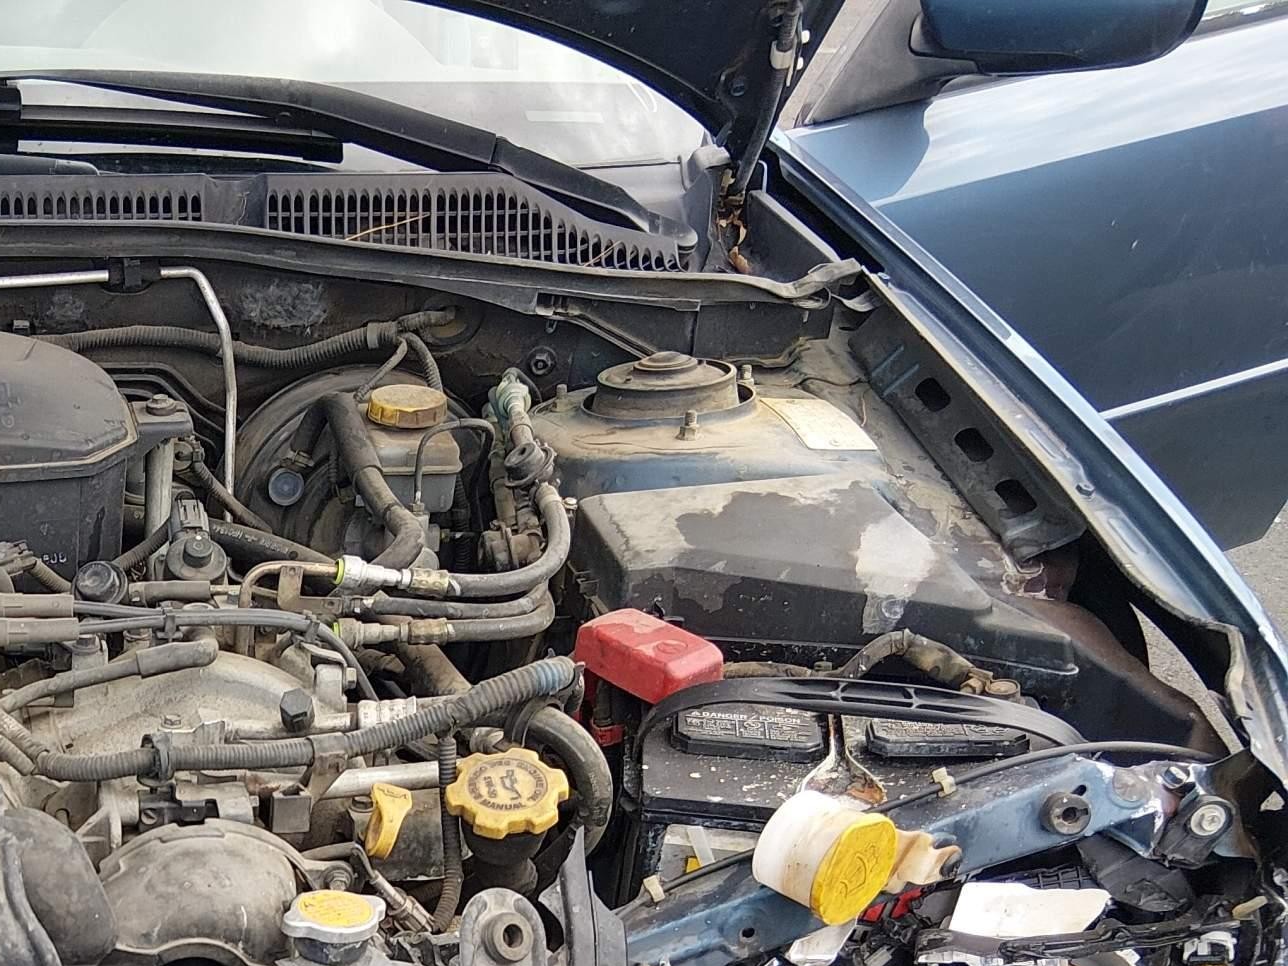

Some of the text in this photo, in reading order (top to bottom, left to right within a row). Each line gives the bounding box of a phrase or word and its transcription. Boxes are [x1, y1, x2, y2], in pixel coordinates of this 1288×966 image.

[702, 711, 748, 721] DANGER
[759, 715, 801, 724] POISON
[480, 799, 526, 811] MANUAL
